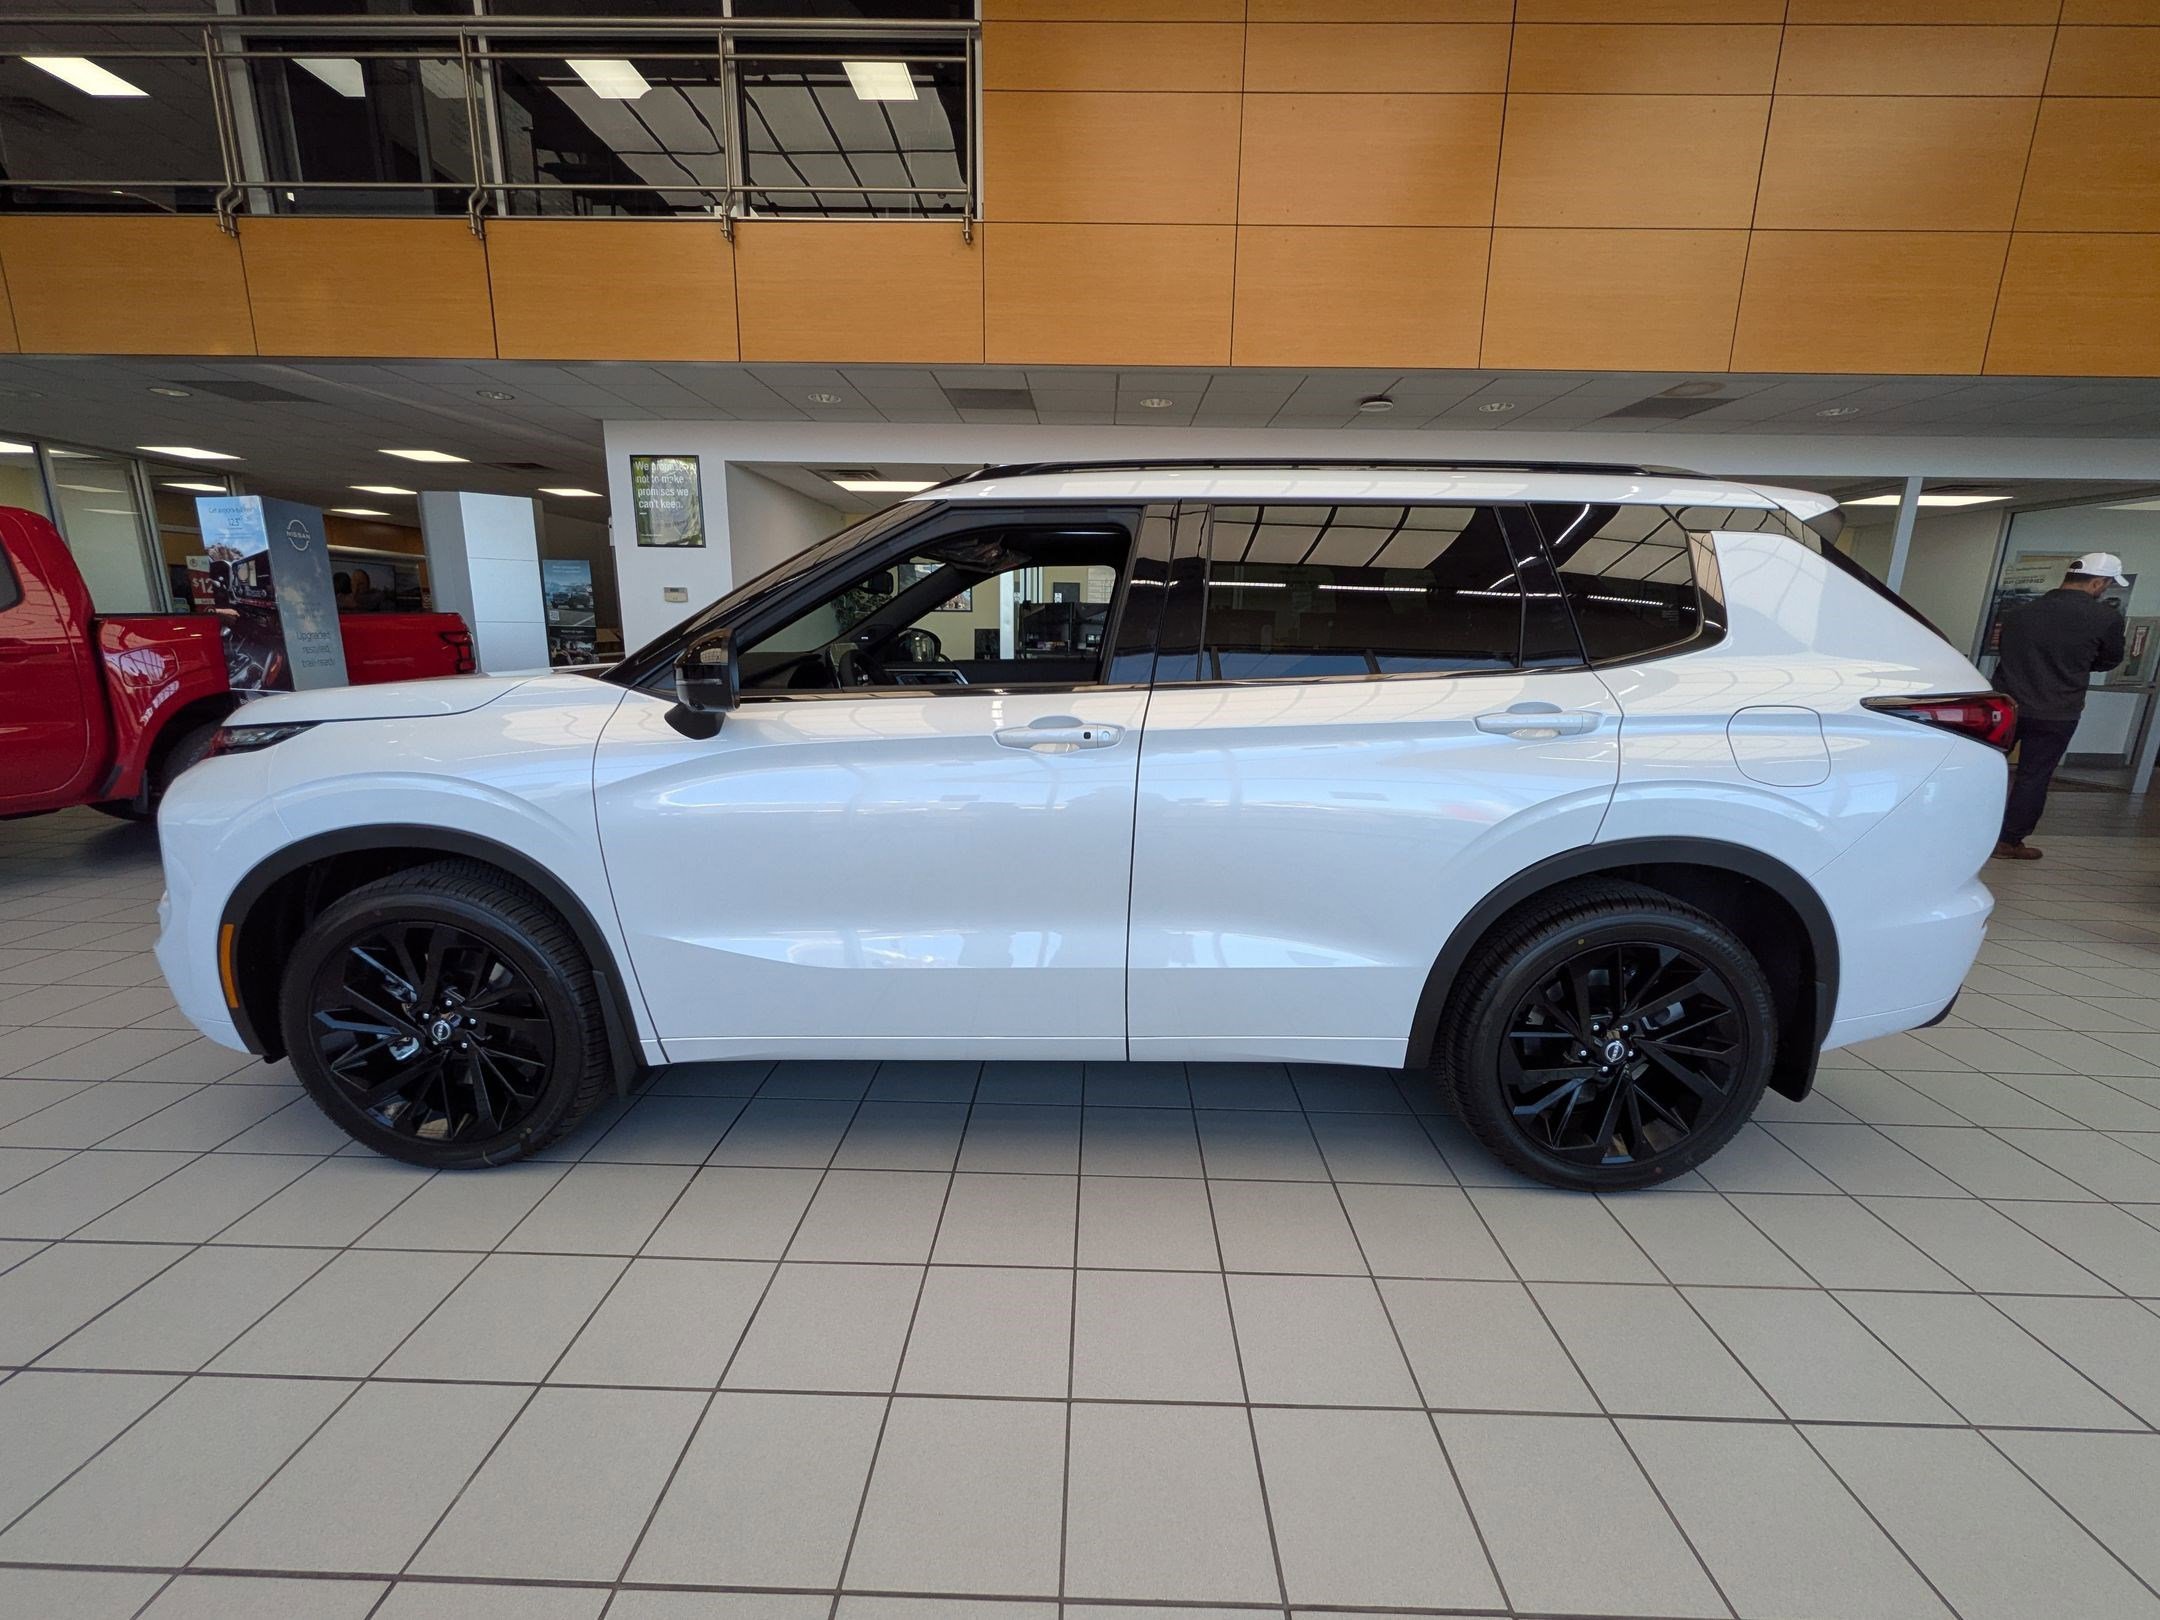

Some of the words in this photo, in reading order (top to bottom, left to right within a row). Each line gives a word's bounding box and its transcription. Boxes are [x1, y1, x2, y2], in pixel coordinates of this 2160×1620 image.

[635, 462, 649, 471] We
[636, 475, 649, 483] not
[651, 475, 660, 483] to
[661, 474, 684, 483] make
[638, 488, 674, 497] promises
[676, 488, 689, 497] we
[638, 499, 659, 509] can't
[661, 499, 683, 510] keep.
[286, 530, 311, 540] NISSAN
